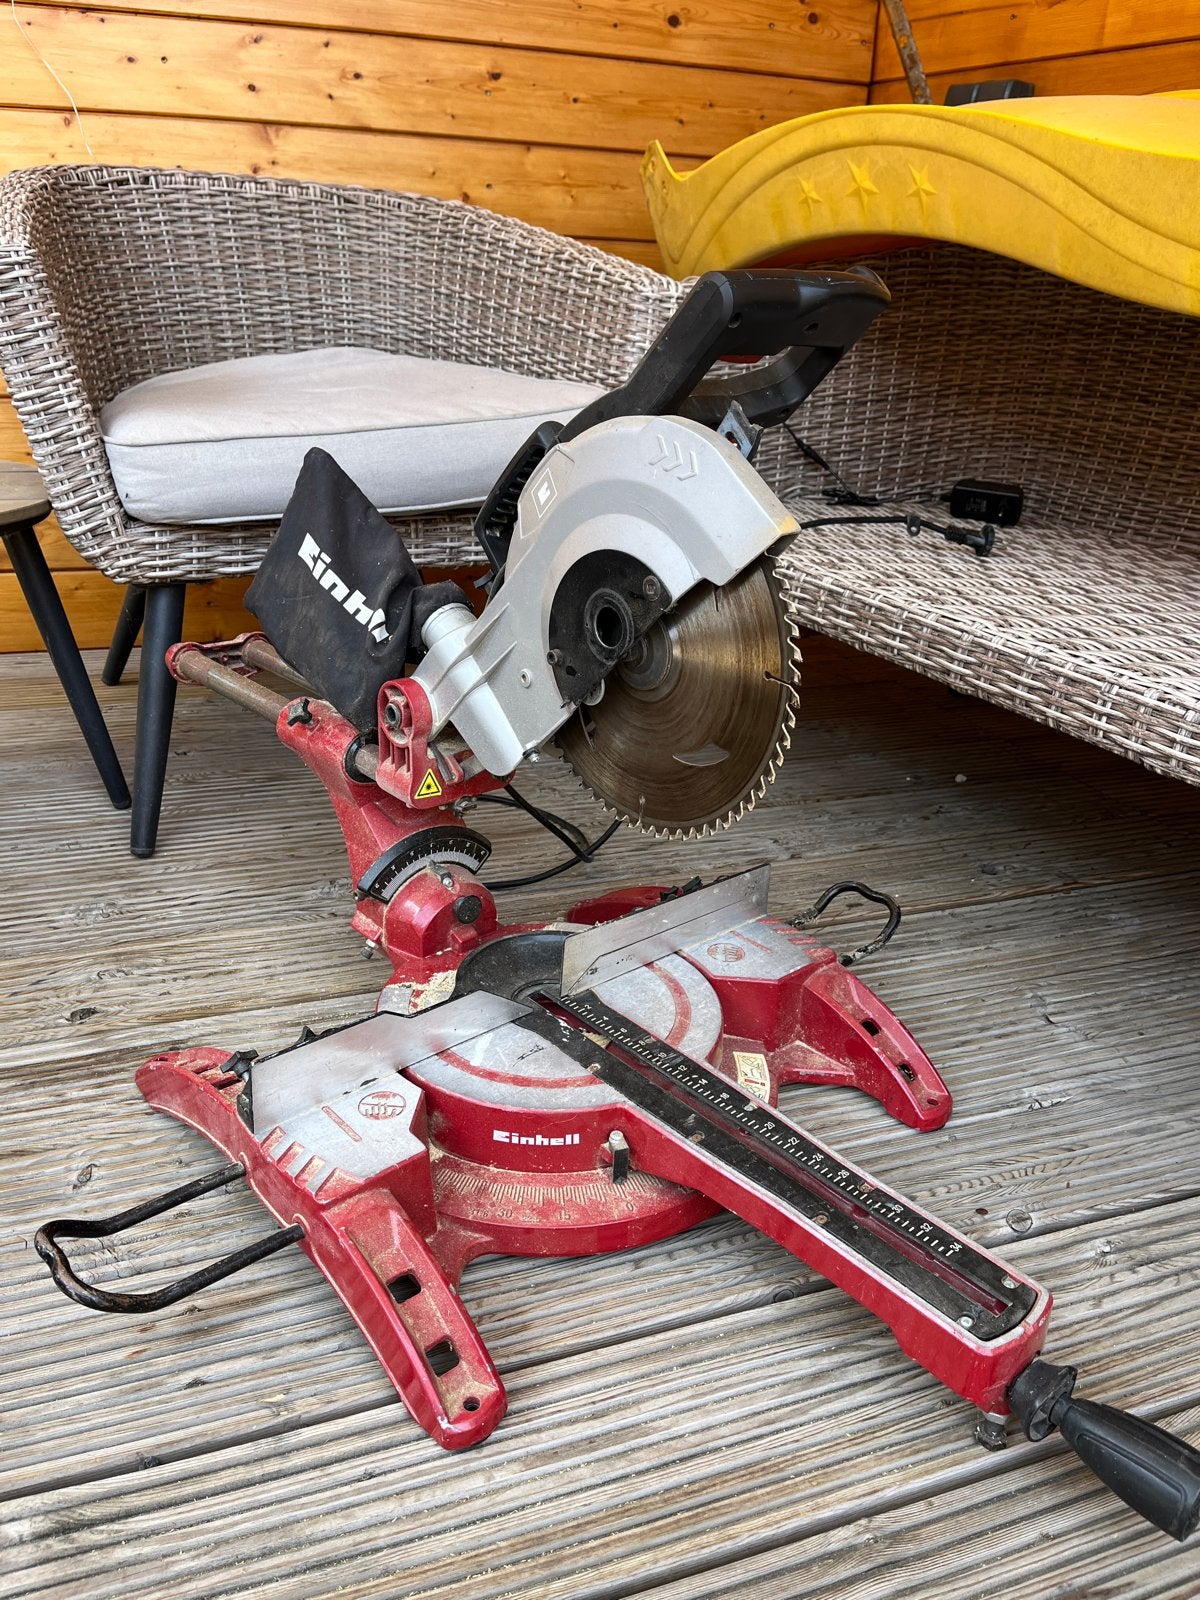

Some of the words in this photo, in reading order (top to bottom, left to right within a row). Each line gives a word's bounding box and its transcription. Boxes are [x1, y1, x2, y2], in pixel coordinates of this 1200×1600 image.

[493, 1130, 580, 1146] Einhell
[765, 1121, 776, 1130] 20
[788, 1136, 800, 1146] 22
[813, 1153, 825, 1162] 24
[838, 1169, 850, 1179] 26
[892, 1204, 904, 1214] 30
[920, 1222, 933, 1232] 32
[949, 1241, 963, 1252] 34
[497, 1208, 513, 1219] 30
[558, 1210, 572, 1221] 15
[626, 1201, 635, 1212] 0
